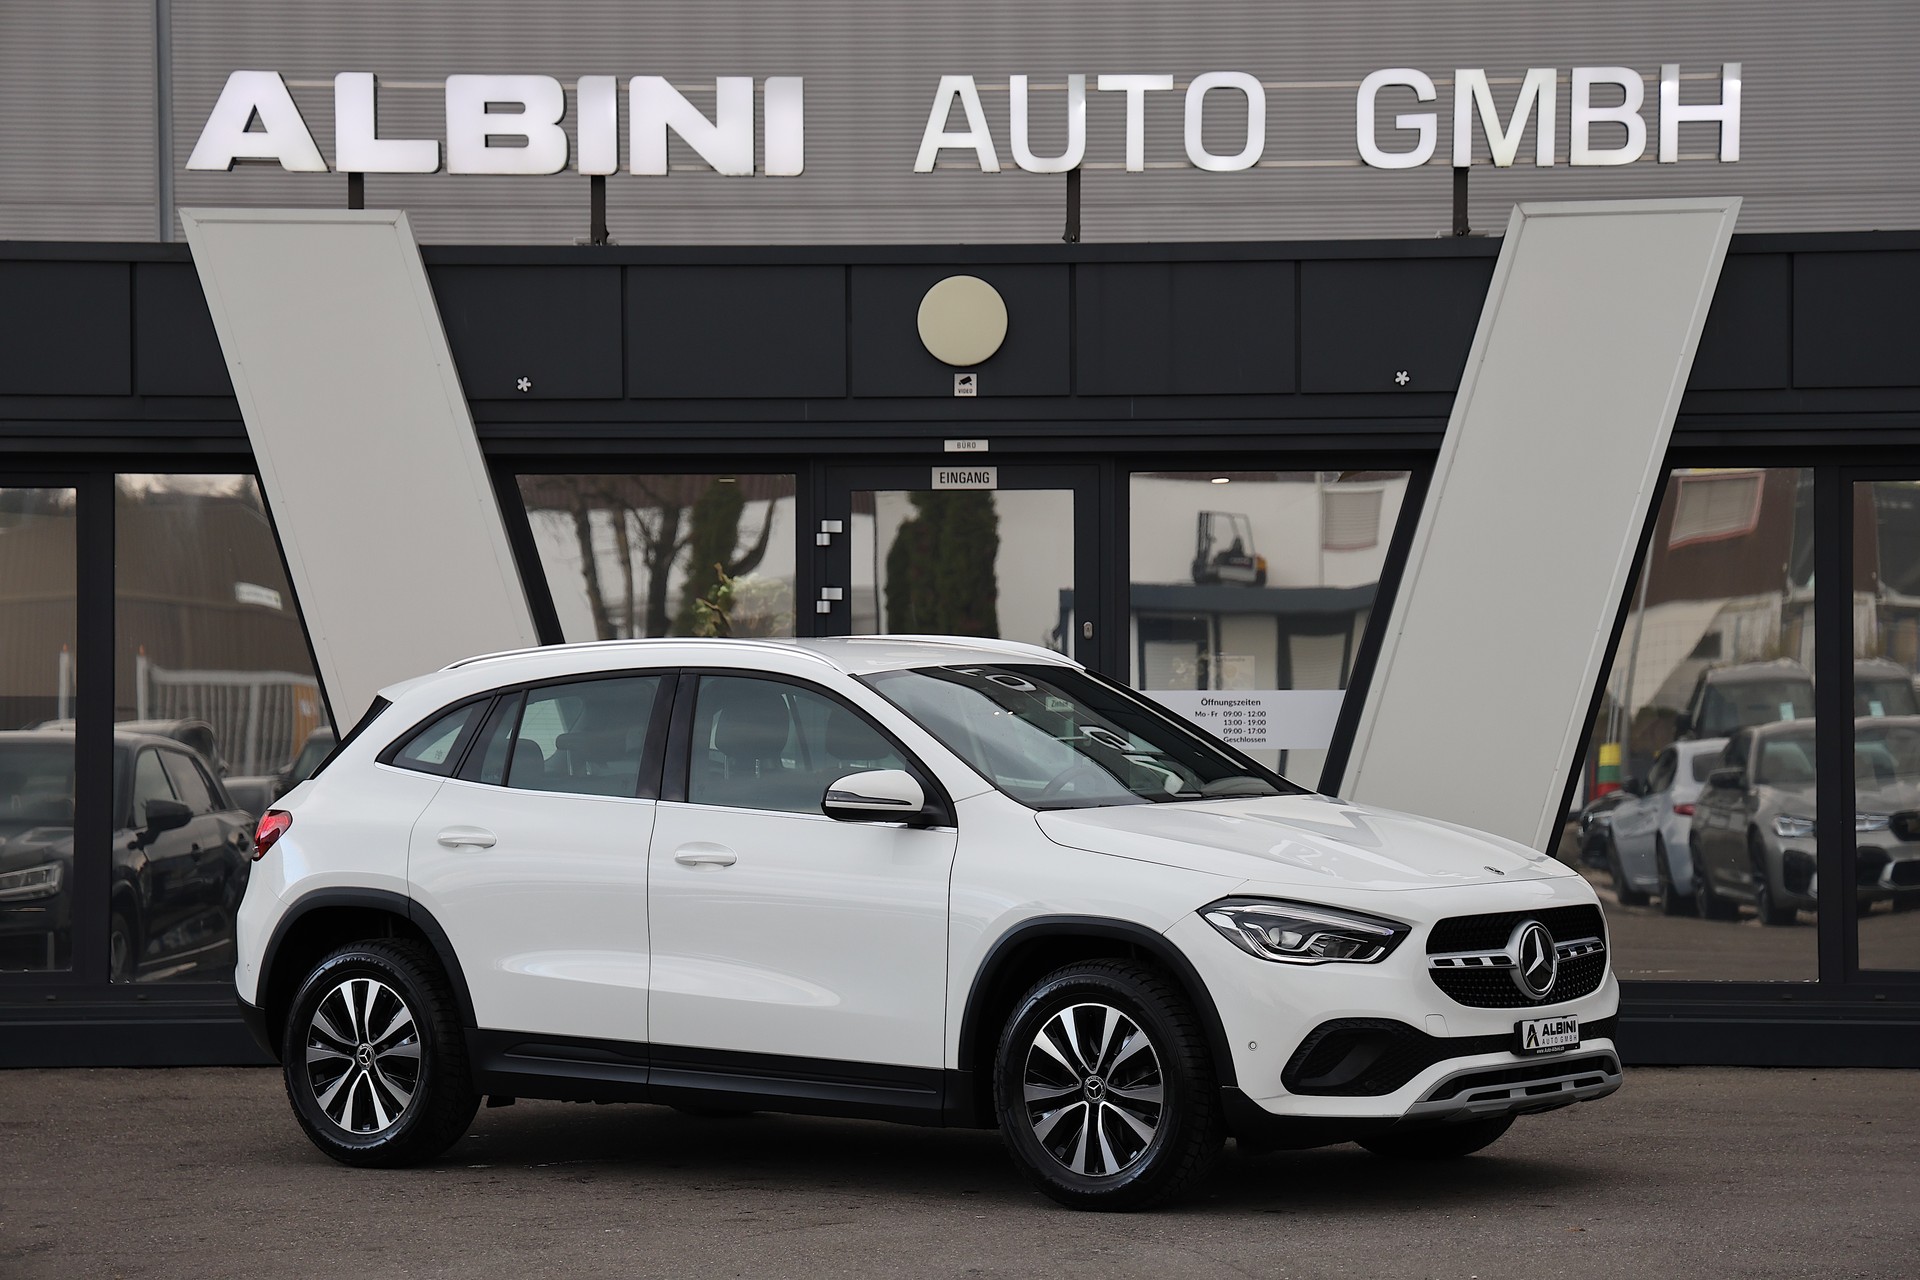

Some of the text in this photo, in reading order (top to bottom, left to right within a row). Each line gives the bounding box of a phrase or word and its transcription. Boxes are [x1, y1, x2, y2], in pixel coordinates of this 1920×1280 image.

[185, 62, 1743, 177] ALBINI AUTO GMBH
[956, 440, 977, 449] BÜRO
[939, 471, 990, 484] EINGANG
[1200, 698, 1261, 707] Öffnungszeiten
[1542, 1020, 1576, 1036] ALBINI
[1541, 1035, 1578, 1045] AUTO GMBH
